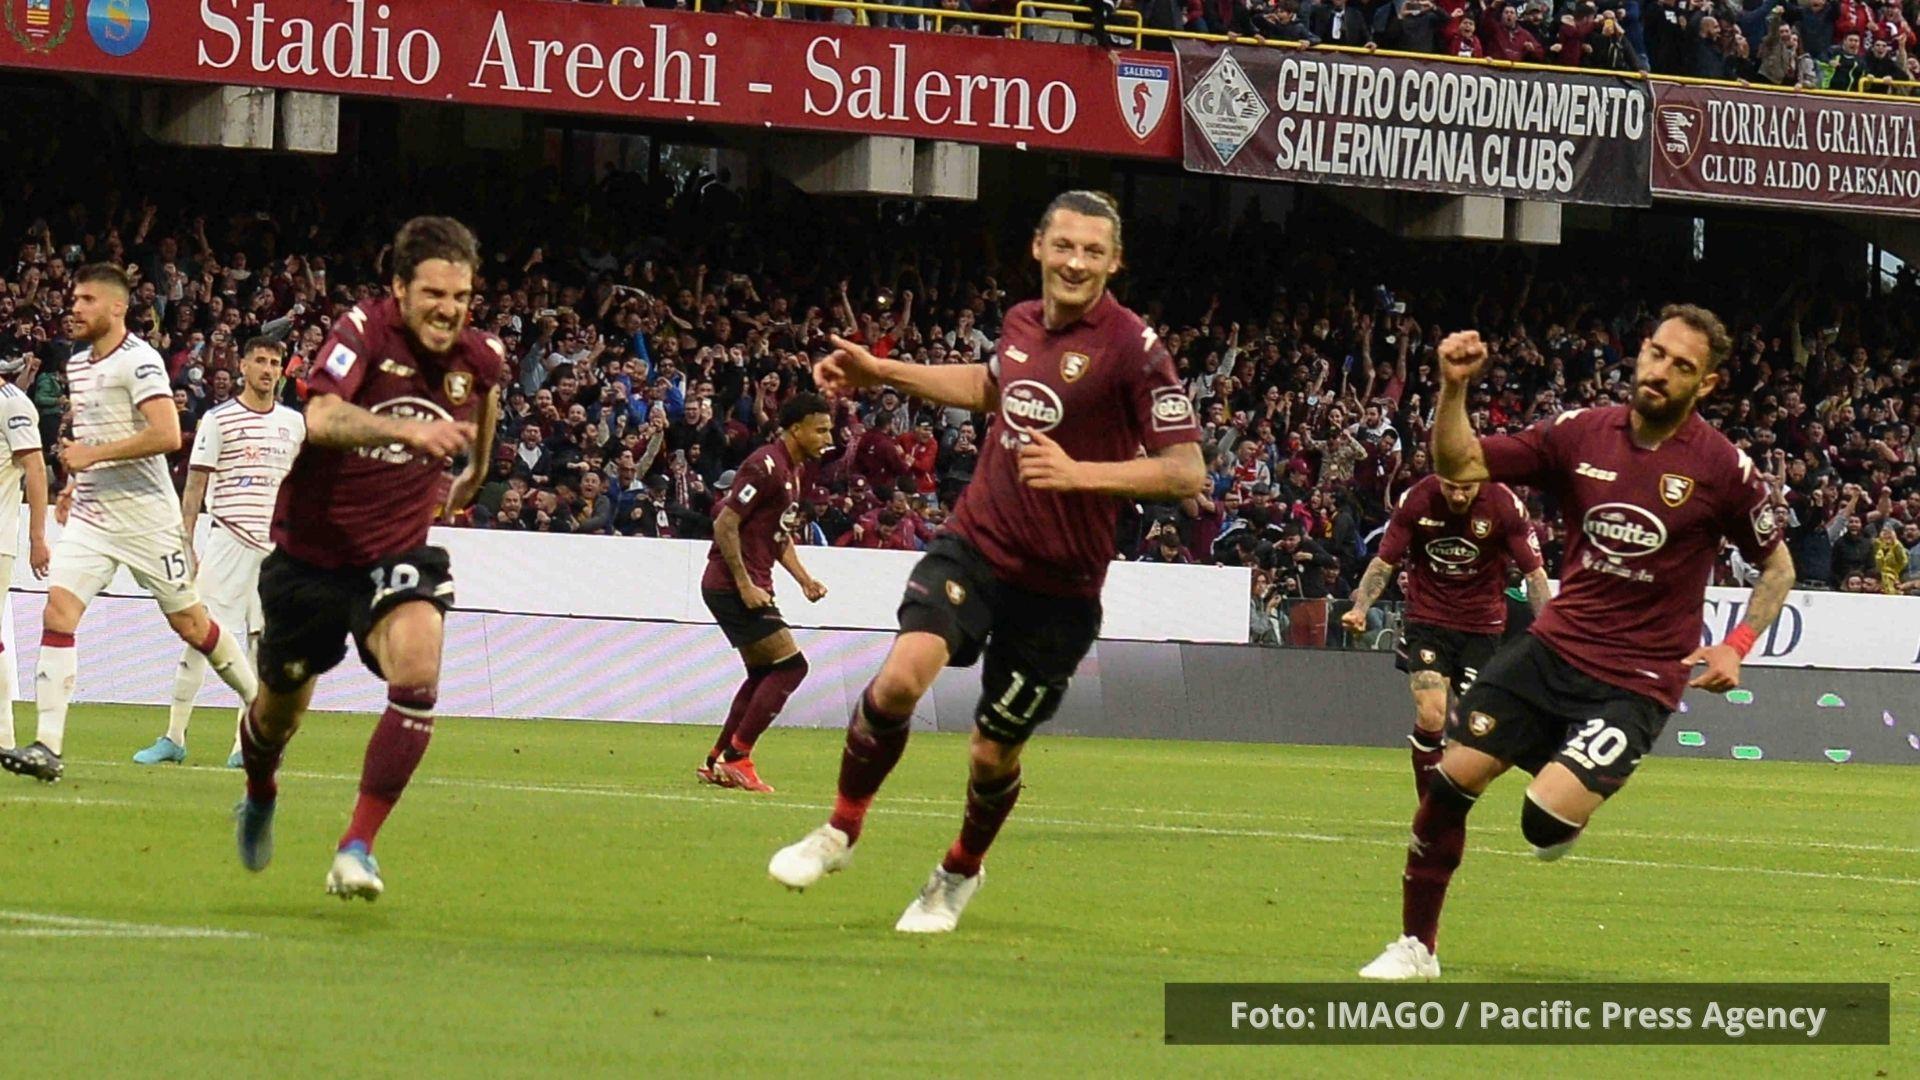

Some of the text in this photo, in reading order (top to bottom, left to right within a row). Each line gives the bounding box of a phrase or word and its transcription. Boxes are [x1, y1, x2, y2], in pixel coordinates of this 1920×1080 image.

[198, 0, 1077, 134] Stadio Arechi - Salerno
[1123, 65, 1164, 79] SALERNO
[1276, 57, 1645, 140] CENTRO COORDINAMENTO
[1707, 99, 1918, 159] TORRACA GRANATA
[1276, 116, 1576, 194] SALERNITANA CLUBS
[1701, 153, 1920, 198] CLUB ALDO PAESANO
[1004, 394, 1058, 422] motta
[1588, 518, 1661, 548] motta
[160, 550, 186, 581] 15
[1000, 671, 1048, 719] 11
[1566, 718, 1628, 766] 20
